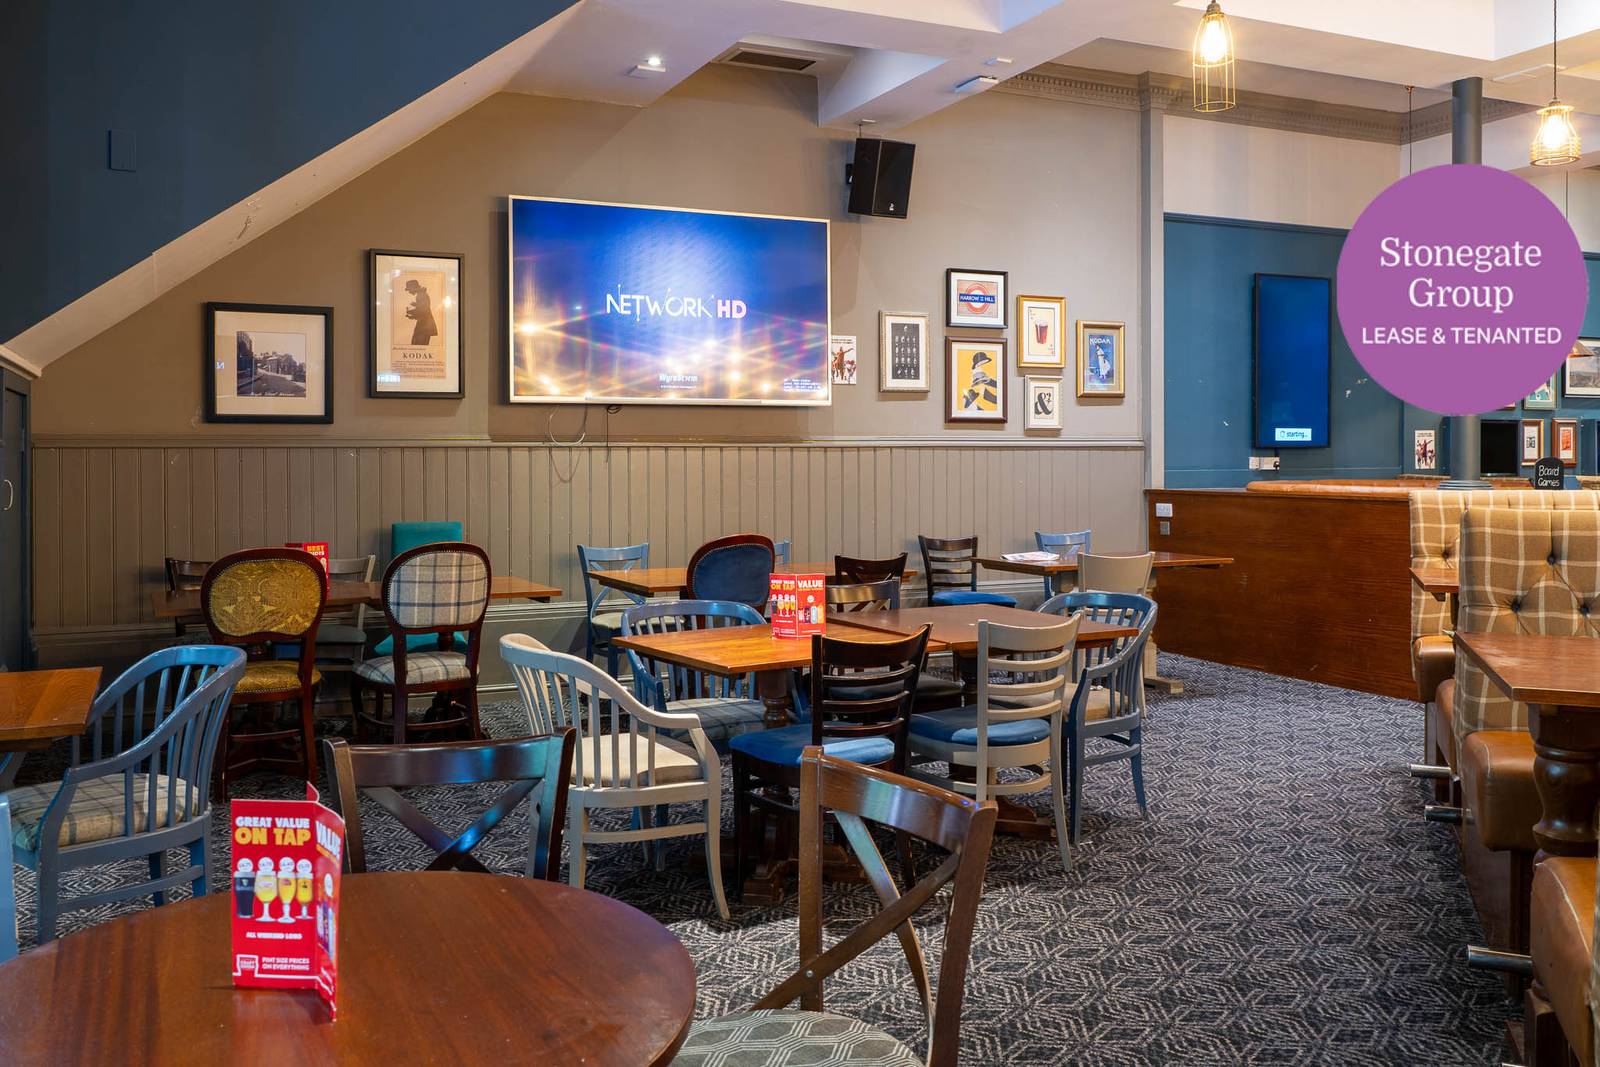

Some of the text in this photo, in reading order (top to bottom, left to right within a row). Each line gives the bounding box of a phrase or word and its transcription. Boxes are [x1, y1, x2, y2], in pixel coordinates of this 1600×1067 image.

[606, 286, 747, 321] NETWORK HD
[1089, 337, 1111, 345] KODAK
[402, 352, 433, 360] KODAK
[1538, 465, 1560, 477] Board
[1537, 477, 1560, 487] Games
[783, 583, 795, 591] TAP
[797, 579, 824, 589] VALUE
[235, 816, 310, 829] GREAT VALUE
[234, 827, 312, 846] ON TAP
[315, 819, 342, 861] VALUE
[289, 957, 310, 965] PRICES
